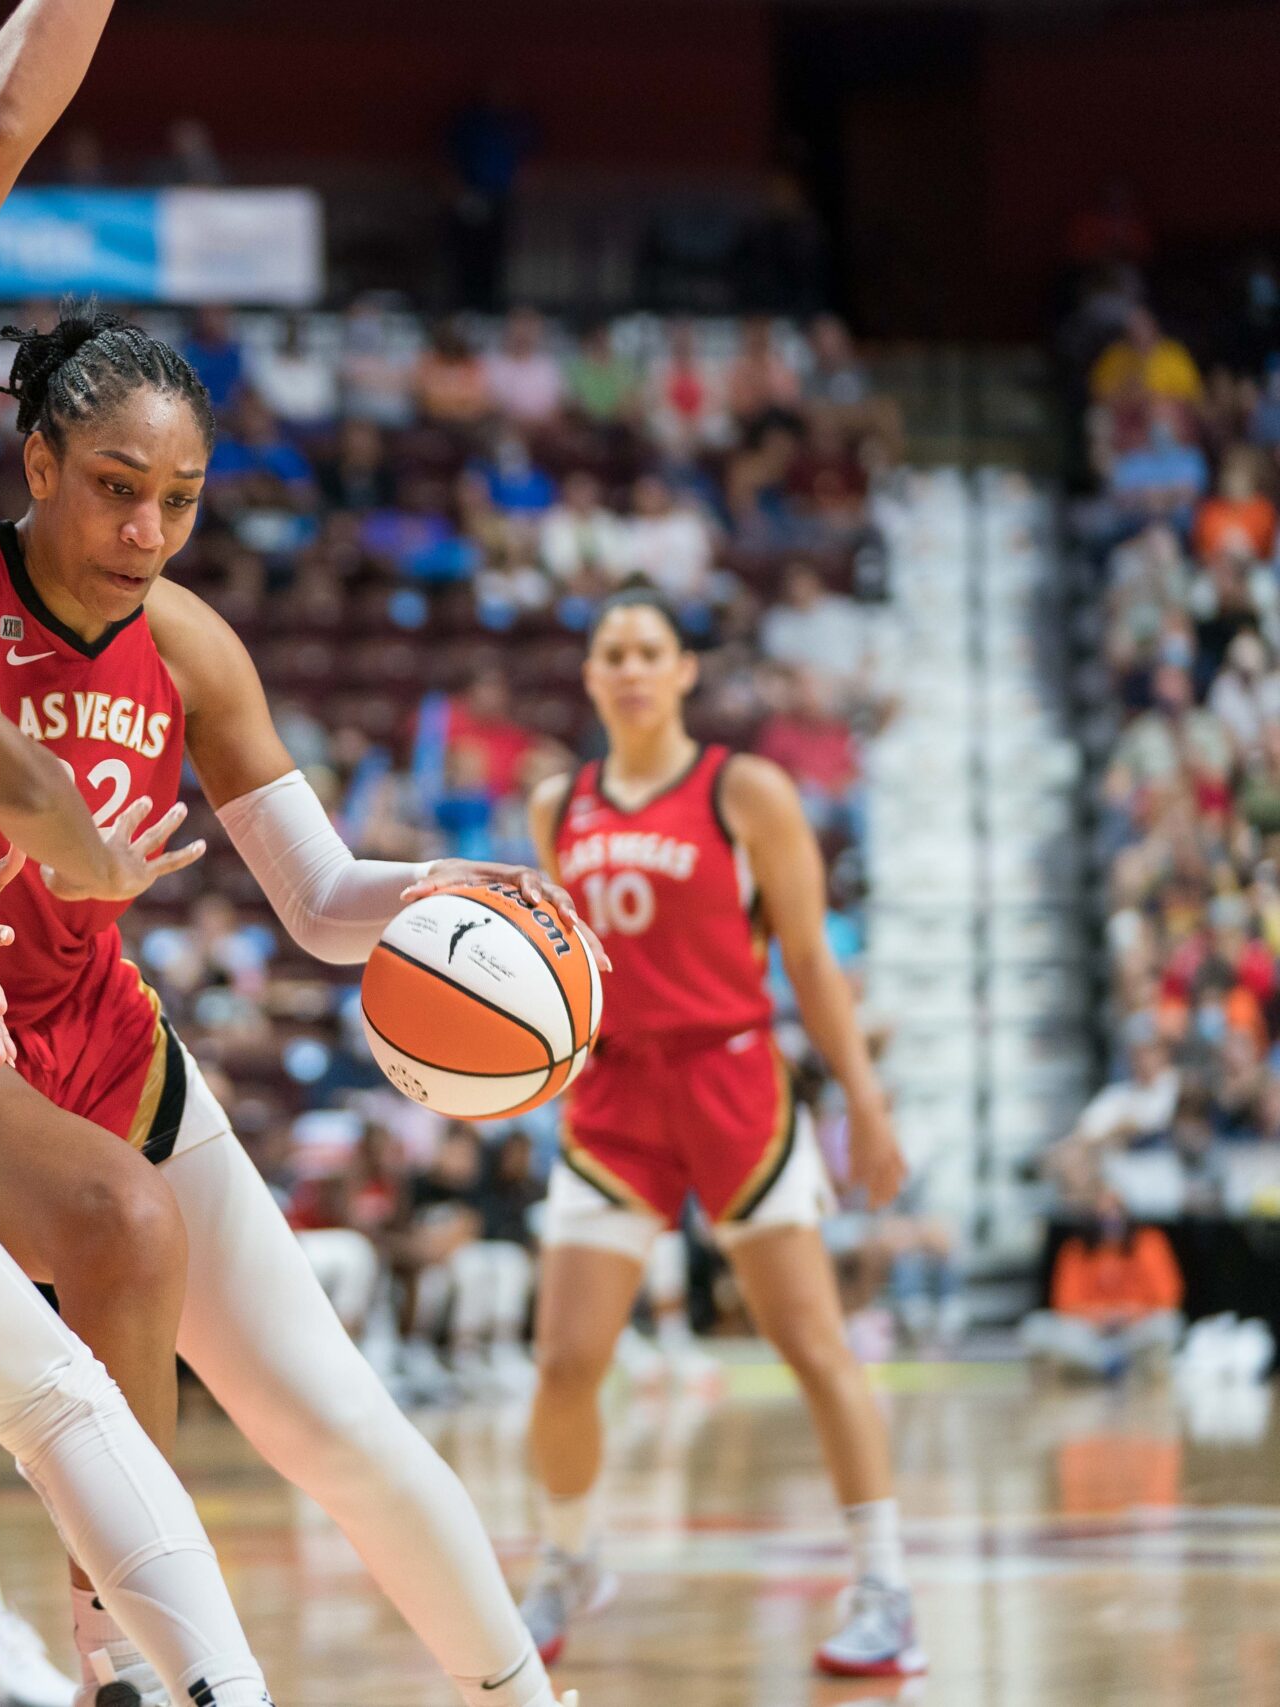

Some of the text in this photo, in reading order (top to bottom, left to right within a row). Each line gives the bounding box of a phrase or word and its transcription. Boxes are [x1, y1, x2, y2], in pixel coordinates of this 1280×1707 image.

[73, 691, 171, 759] VEGAS
[56, 758, 131, 844] 2
[582, 870, 656, 939] 10
